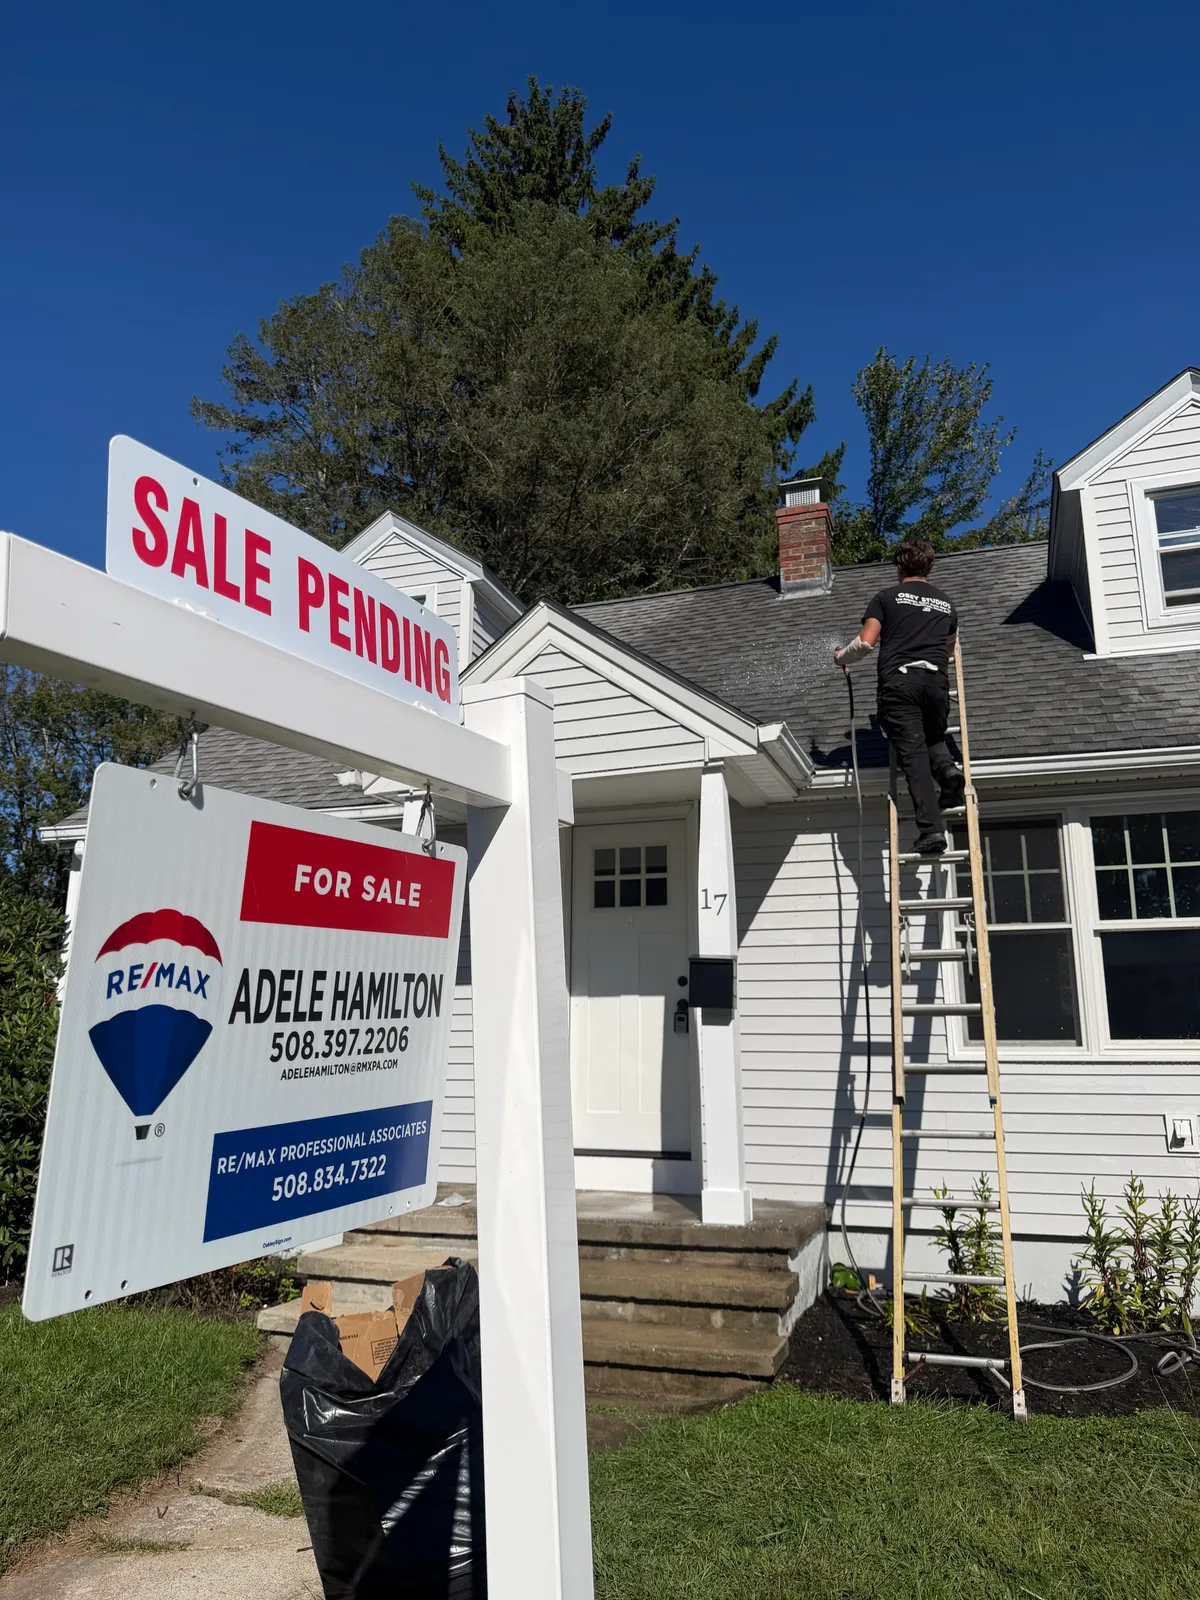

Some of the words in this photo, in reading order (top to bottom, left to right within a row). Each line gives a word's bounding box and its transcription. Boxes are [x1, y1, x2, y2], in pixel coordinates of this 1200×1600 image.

[132, 475, 272, 617] SALE
[298, 556, 451, 704] PENDING
[897, 592, 919, 601] OBEY
[294, 864, 351, 898] FOR
[361, 875, 421, 907] SALE
[701, 888, 728, 916] 17
[106, 962, 210, 1000] RE/MAX
[228, 968, 327, 1025] ADELE
[330, 971, 444, 1021] HAMILTON
[269, 1025, 409, 1063] 508.397.2206
[280, 1059, 398, 1081] ADELEHAMILTON@RMXPA.COM
[217, 1148, 276, 1175] RE/MAX
[279, 1132, 367, 1163] PROFESSIONAL
[368, 1120, 427, 1144] ASSOCIATES
[271, 1154, 387, 1202] 508.834.7322
